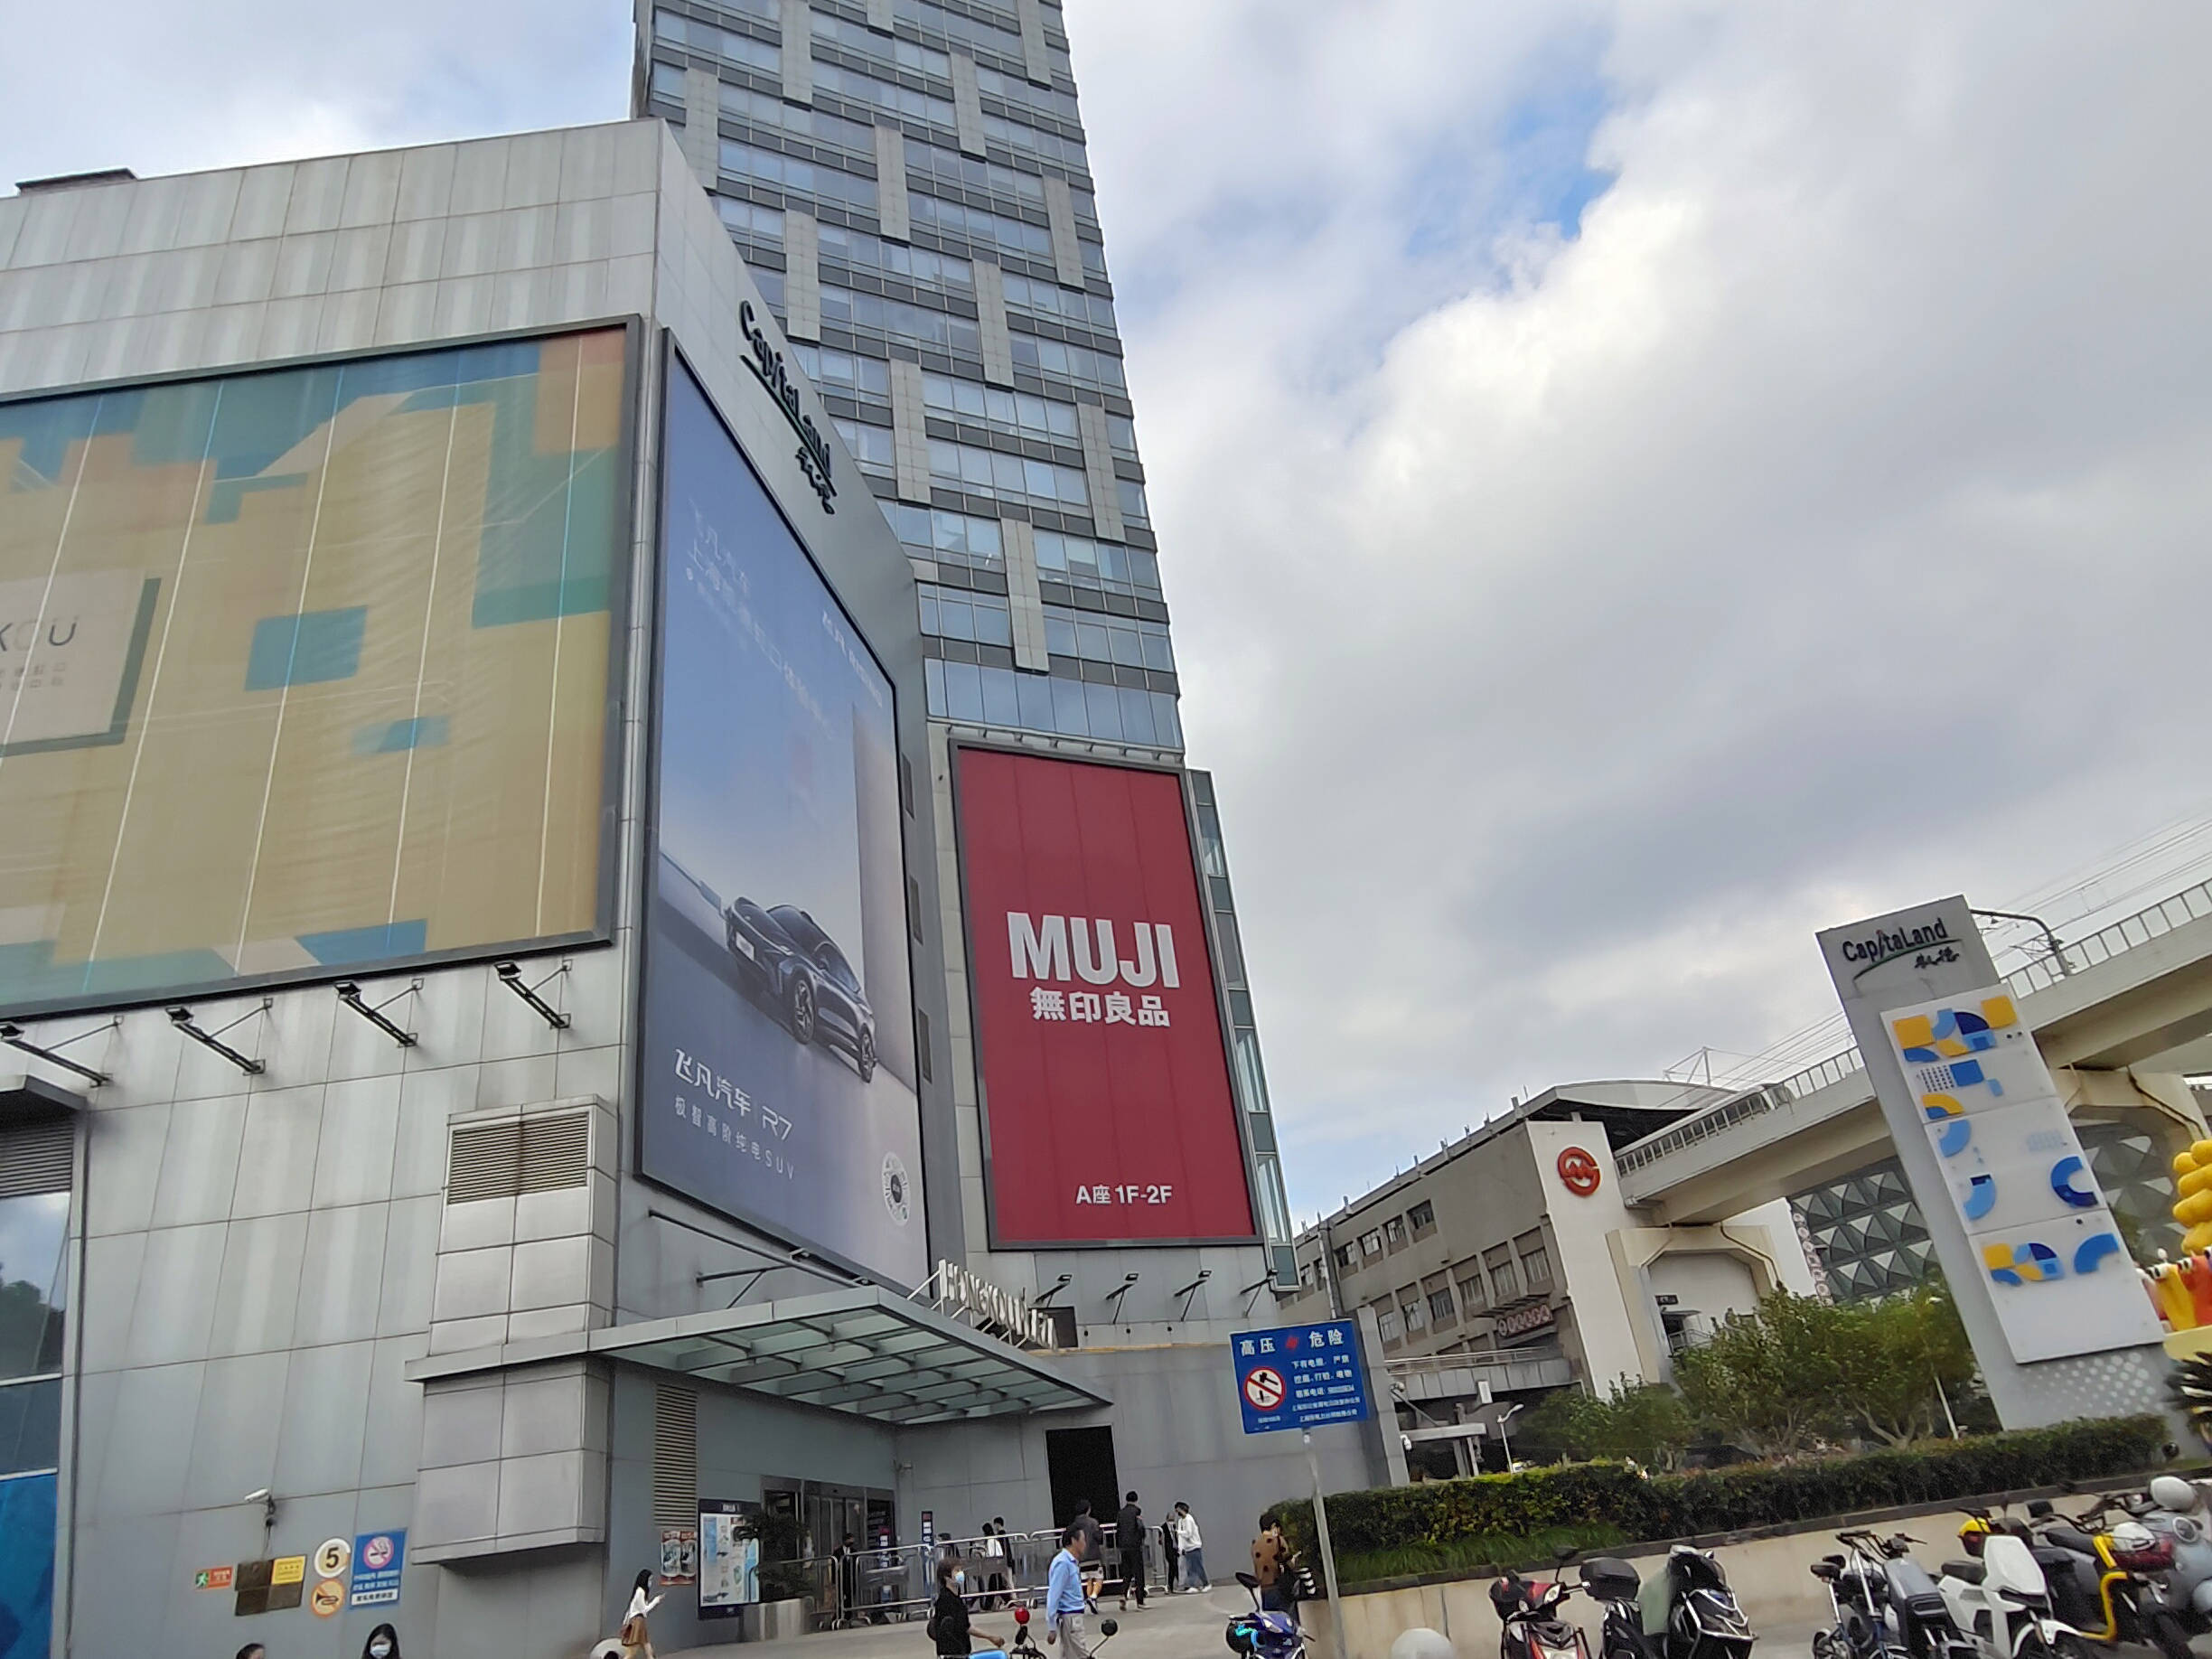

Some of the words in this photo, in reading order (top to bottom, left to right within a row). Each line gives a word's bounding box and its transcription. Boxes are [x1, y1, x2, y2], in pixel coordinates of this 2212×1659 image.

[1007, 911, 1180, 989] MUJI
[1842, 916, 1949, 963] CapitaLand
[1030, 986, 1171, 1027] 無印良品
[675, 1048, 752, 1117] 飞凡汽车
[762, 1105, 792, 1140] R7
[1075, 1184, 1112, 1204] A座
[1114, 1184, 1173, 1204] 1F-2F
[1240, 1336, 1276, 1357] 高压
[1308, 1328, 1345, 1349] 危险
[326, 1547, 340, 1569] 5
